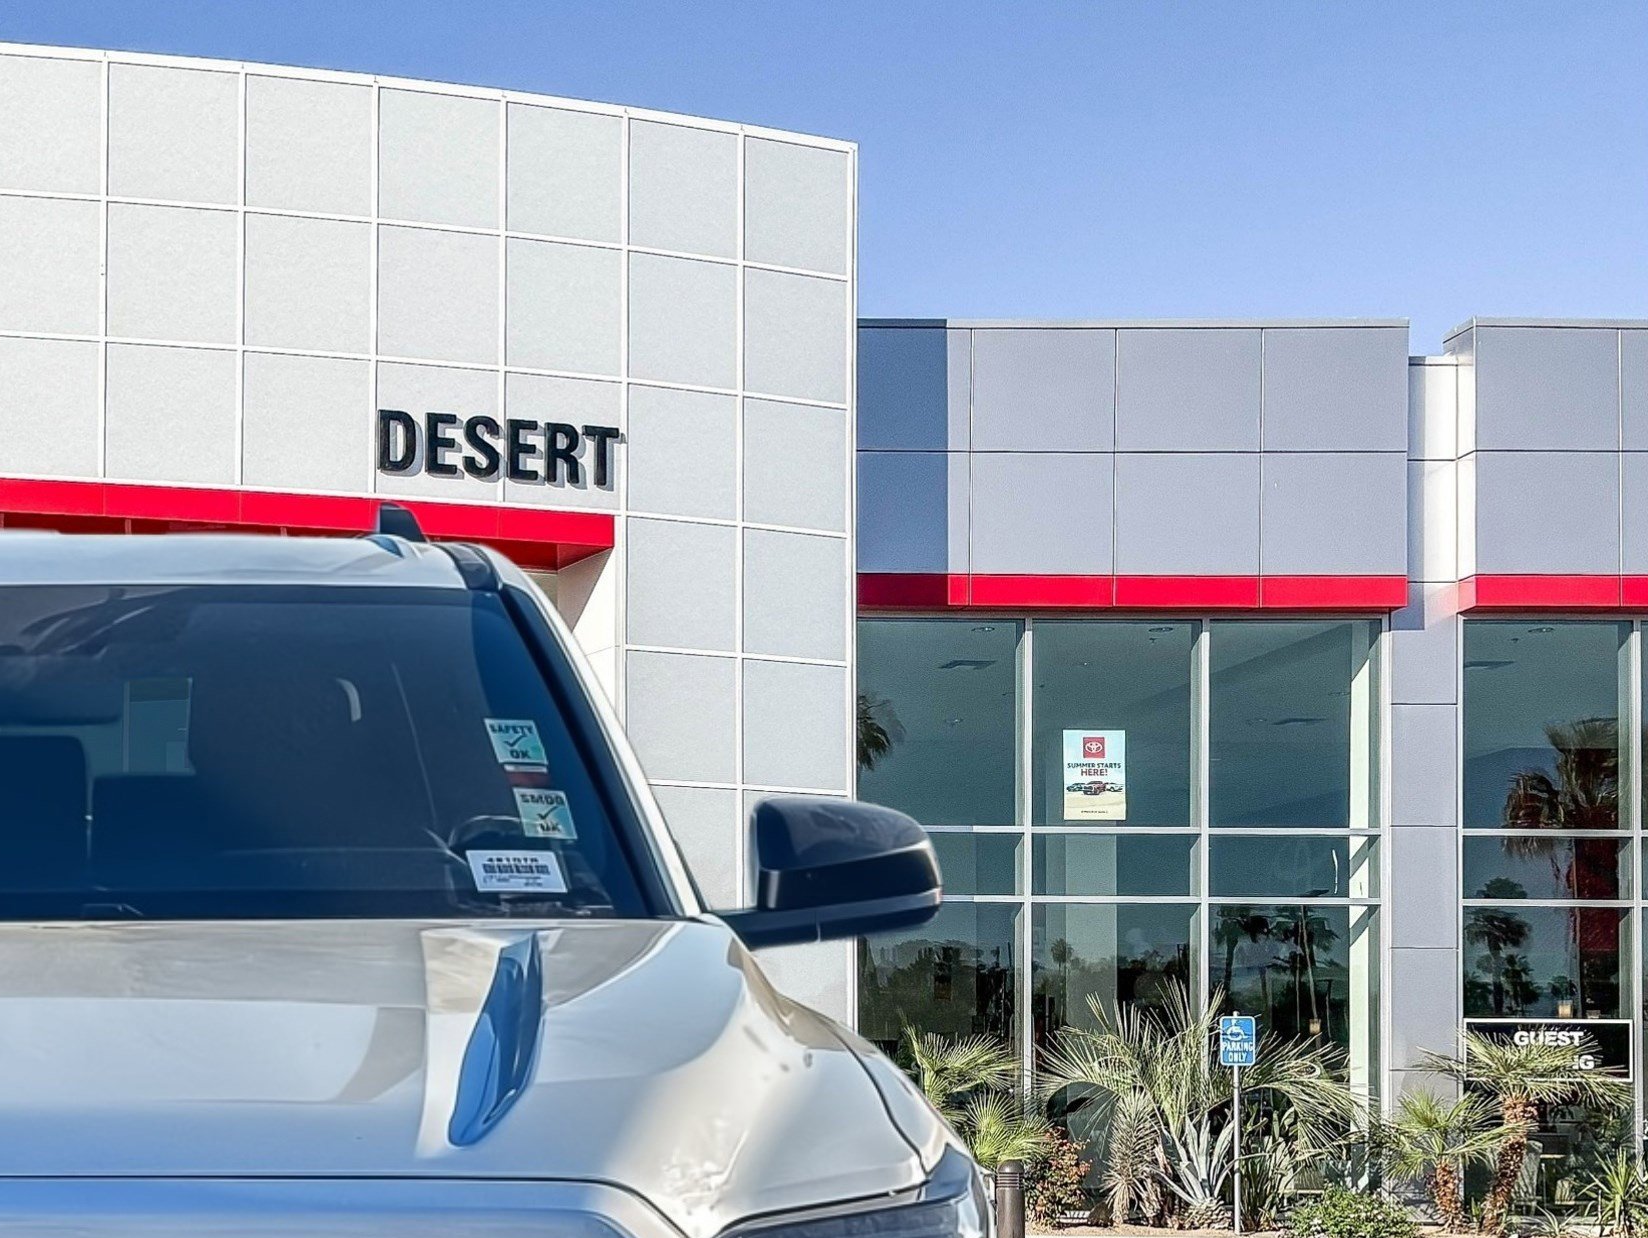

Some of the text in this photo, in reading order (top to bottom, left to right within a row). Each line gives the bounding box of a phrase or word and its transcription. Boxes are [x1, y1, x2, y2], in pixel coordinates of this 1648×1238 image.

[377, 409, 620, 487] DESERT
[489, 723, 535, 735] SAFETY
[509, 749, 531, 759] OK
[1514, 1031, 1584, 1046] GUEST
[1222, 1042, 1253, 1051] PARKING
[1228, 1052, 1247, 1062] ONLY
